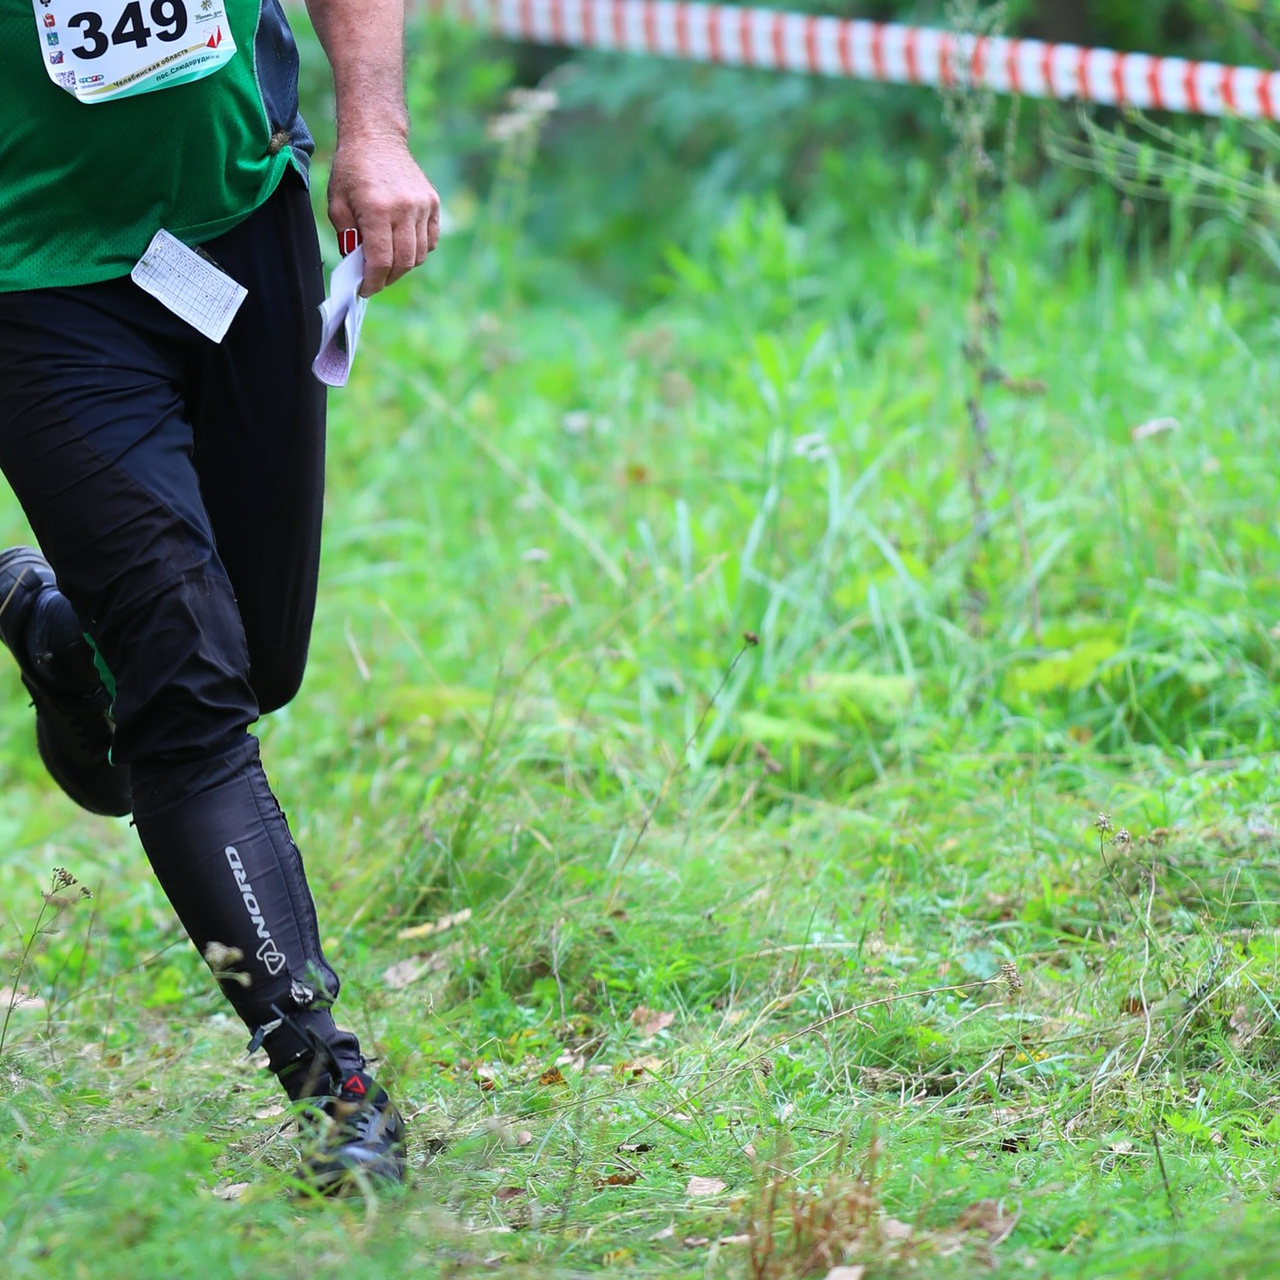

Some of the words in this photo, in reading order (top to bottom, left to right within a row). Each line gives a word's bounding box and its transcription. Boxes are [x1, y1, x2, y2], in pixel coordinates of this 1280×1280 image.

[113, 62, 160, 88] Челябинская
[161, 48, 189, 65] область
[224, 845, 271, 939] NORD
